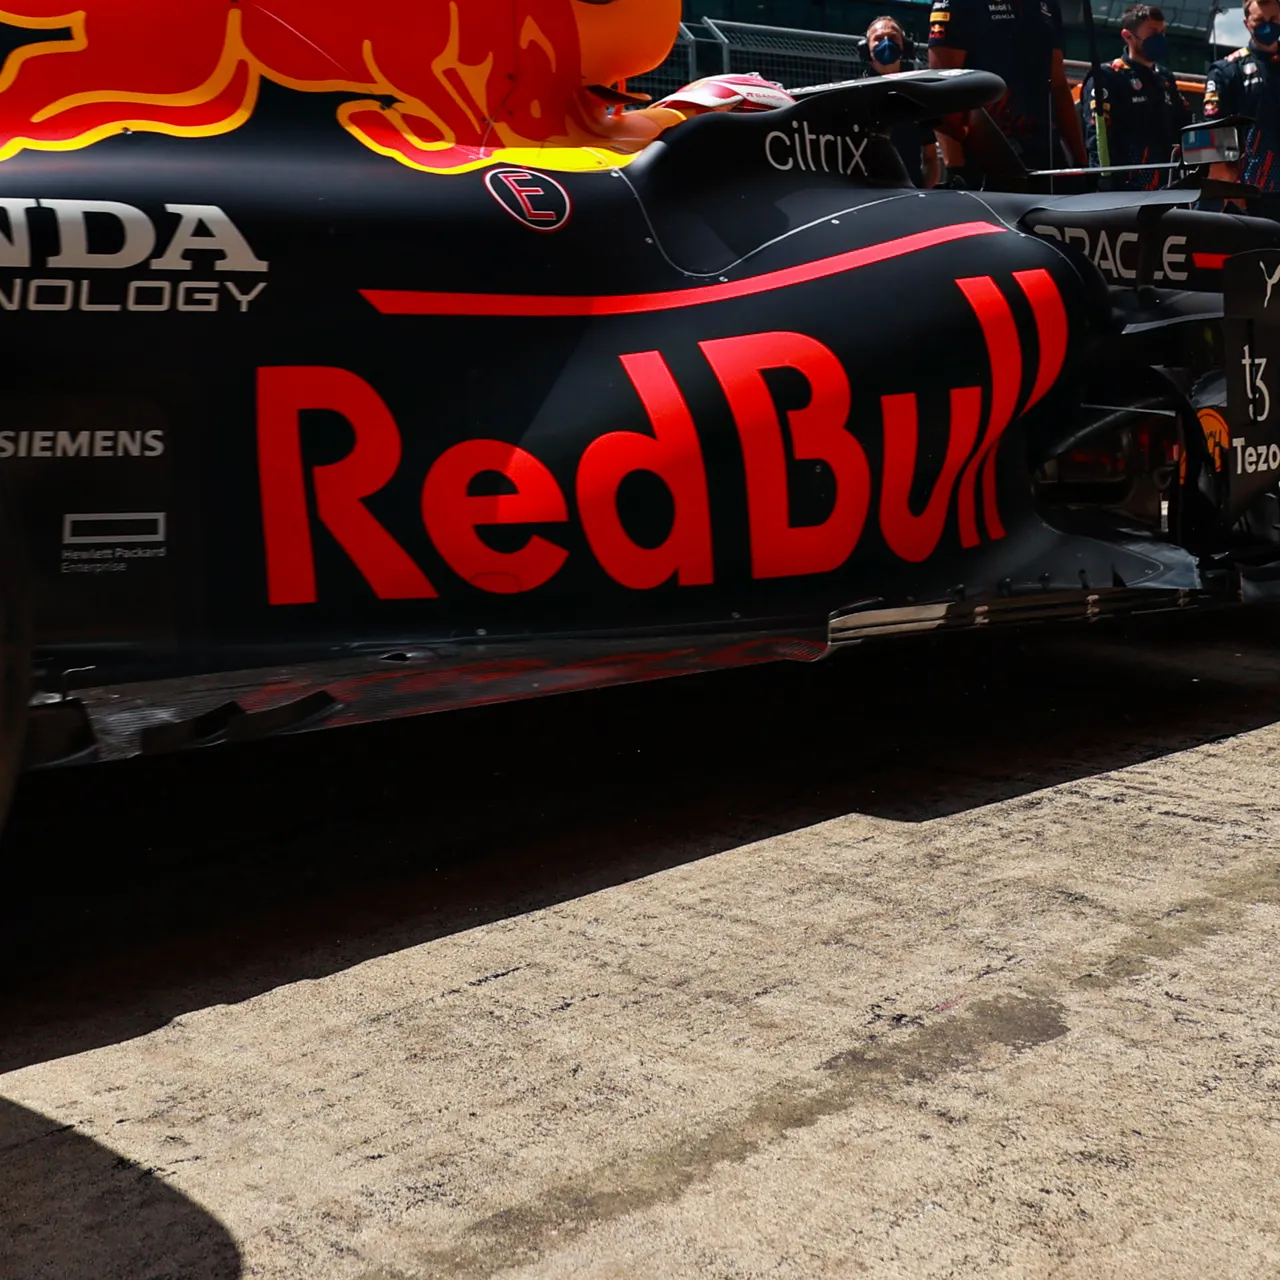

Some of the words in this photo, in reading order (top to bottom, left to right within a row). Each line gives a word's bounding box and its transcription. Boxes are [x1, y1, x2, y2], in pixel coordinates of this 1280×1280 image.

[765, 120, 868, 176] citrix
[497, 172, 557, 220] E
[61, 548, 114, 560] Hewlett
[115, 546, 166, 559] Packard
